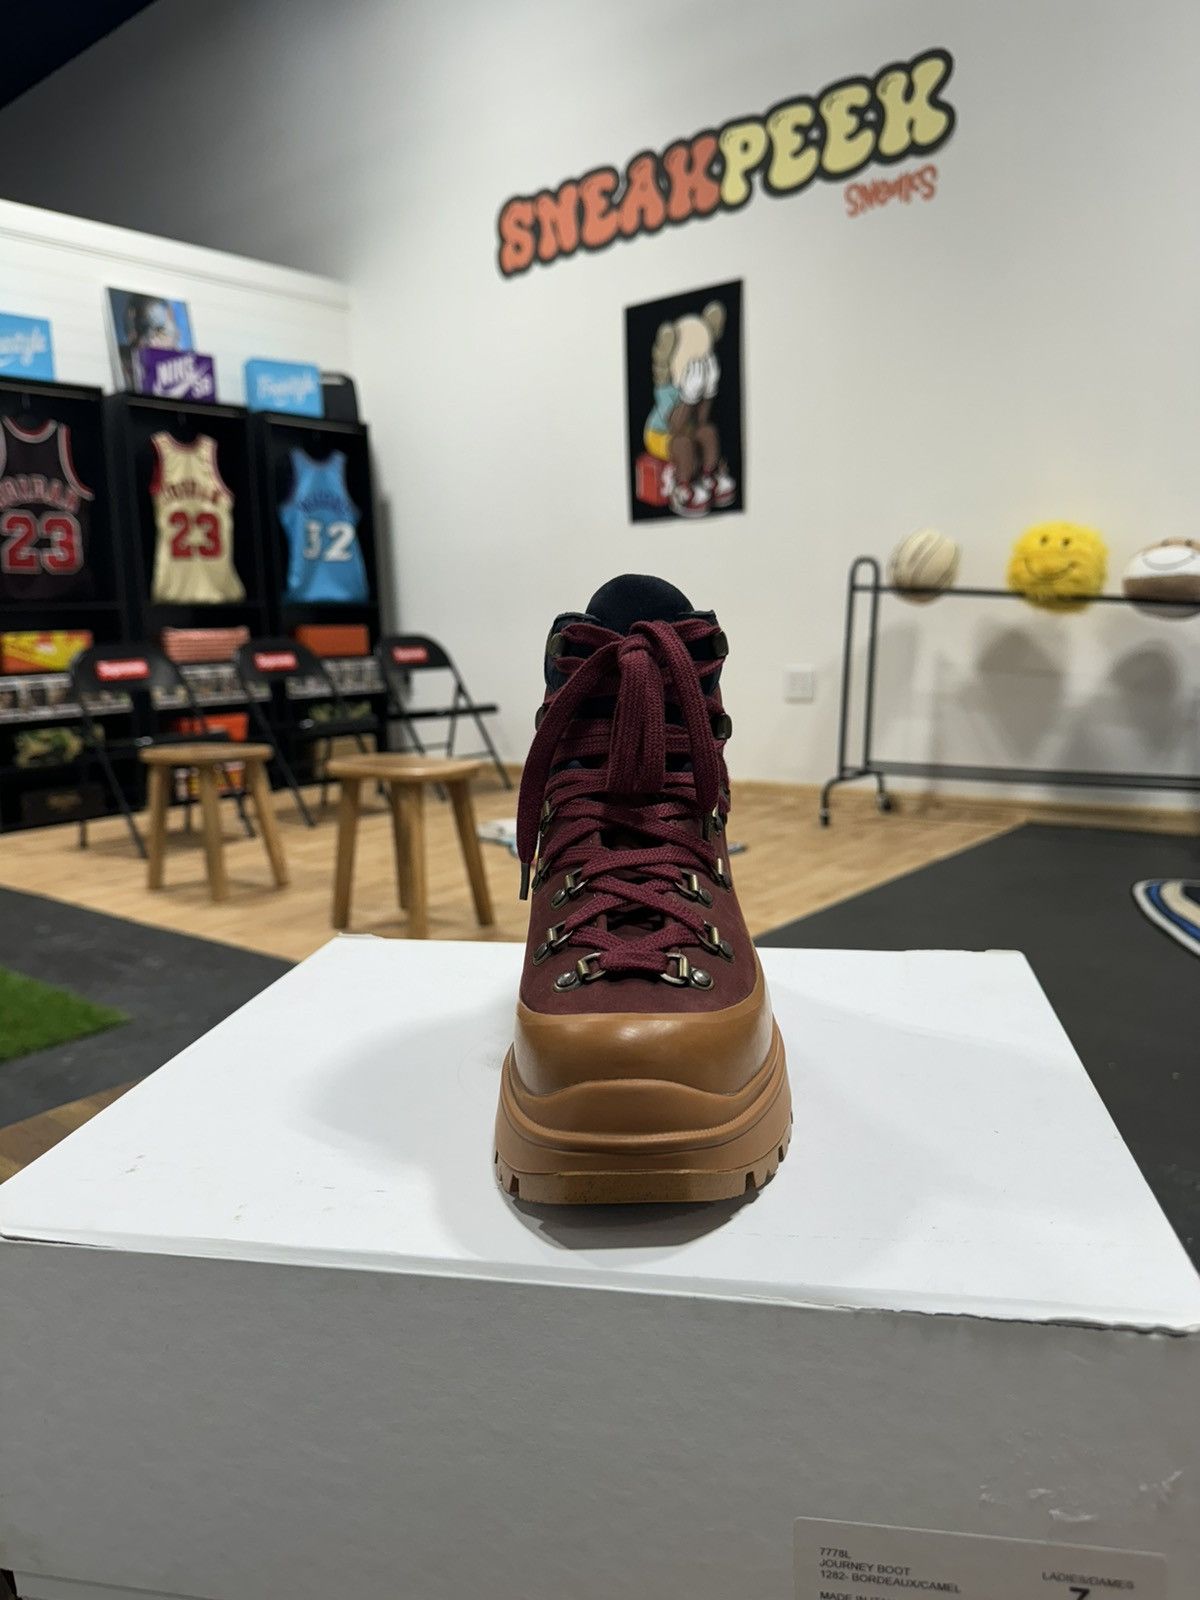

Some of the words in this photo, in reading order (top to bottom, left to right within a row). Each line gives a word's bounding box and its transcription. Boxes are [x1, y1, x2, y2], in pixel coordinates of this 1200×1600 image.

[2, 511, 83, 574] 23
[168, 511, 222, 559] 23
[819, 1558, 874, 1572] JOURNEY
[877, 1564, 911, 1576] BOOT
[851, 1573, 962, 1594] BORDEAUX/CAMEL
